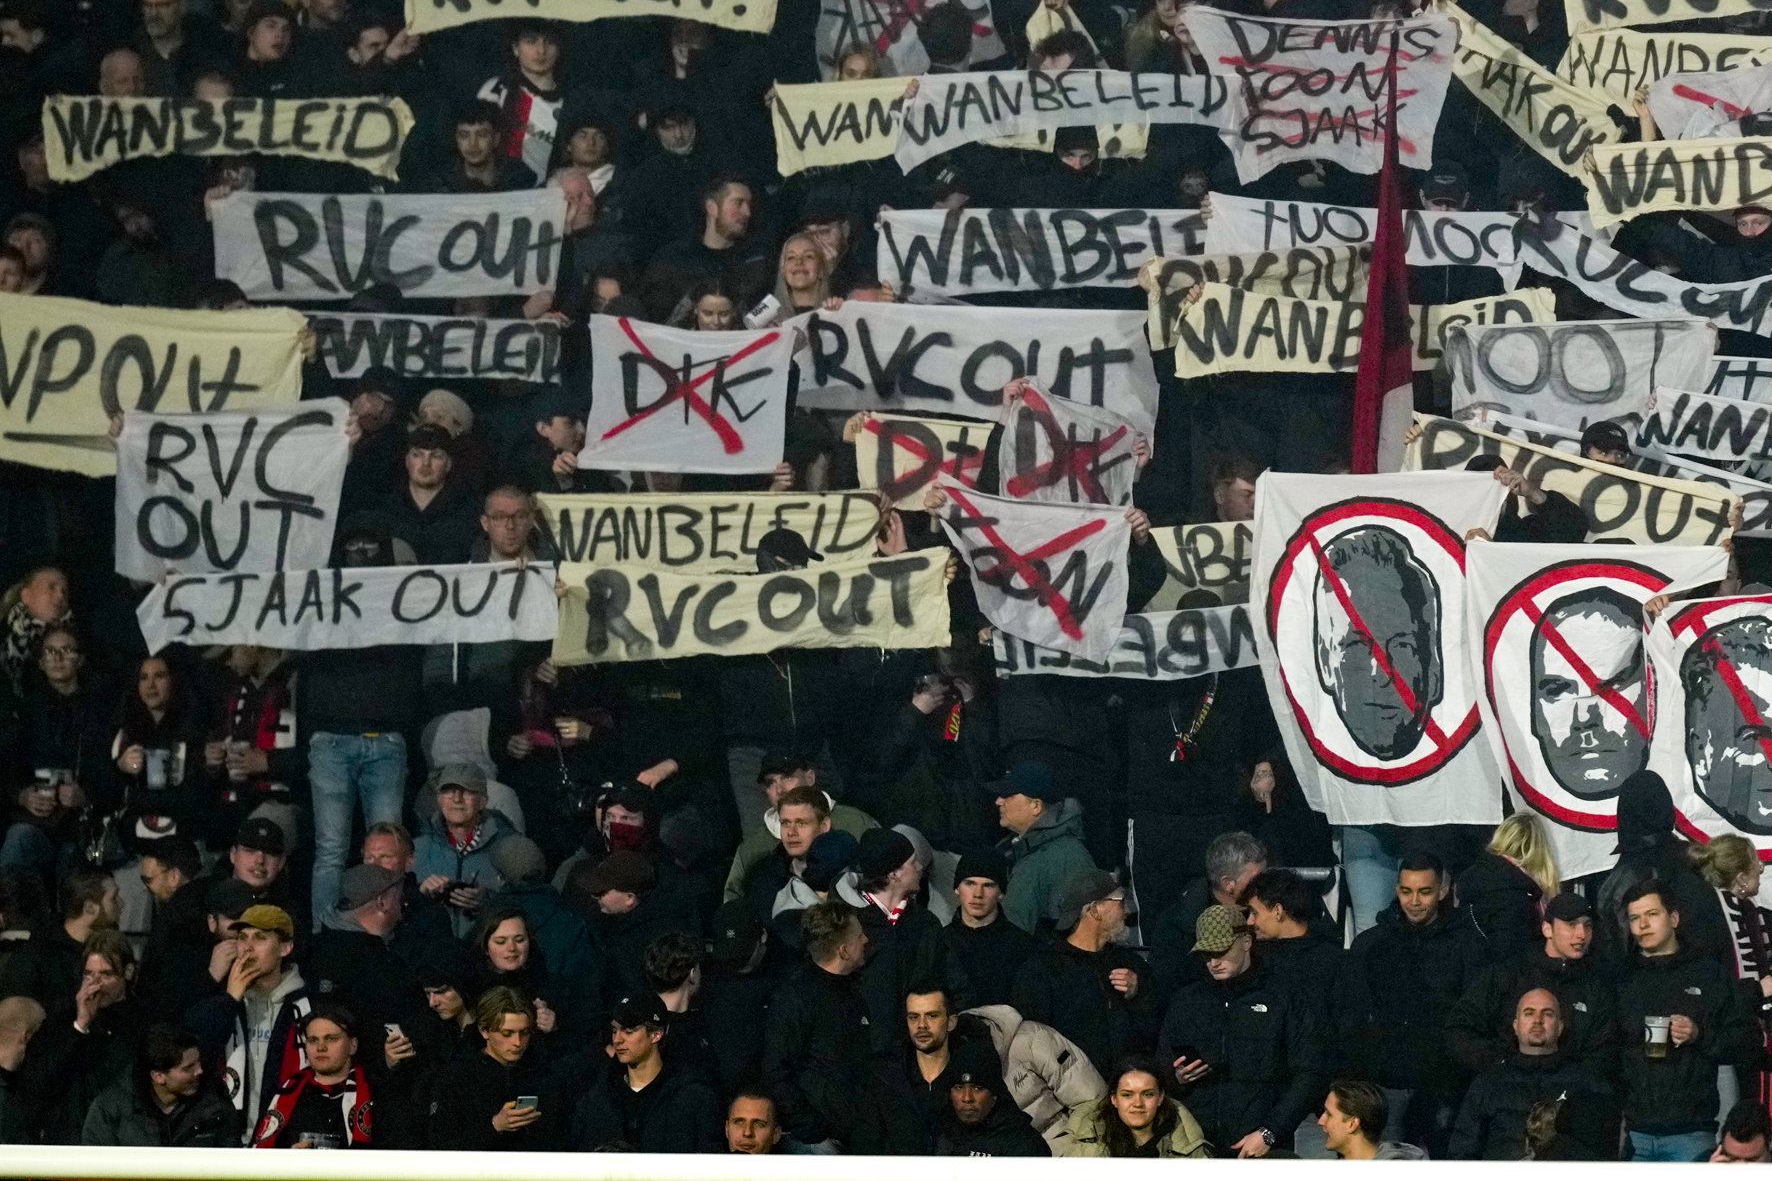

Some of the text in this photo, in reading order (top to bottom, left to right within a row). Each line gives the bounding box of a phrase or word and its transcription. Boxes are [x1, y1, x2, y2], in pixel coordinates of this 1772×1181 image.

[1224, 16, 1442, 65] DENNS
[146, 410, 334, 504] RVC
[137, 494, 325, 573] OUT
[164, 567, 543, 636] SJAAK OUT
